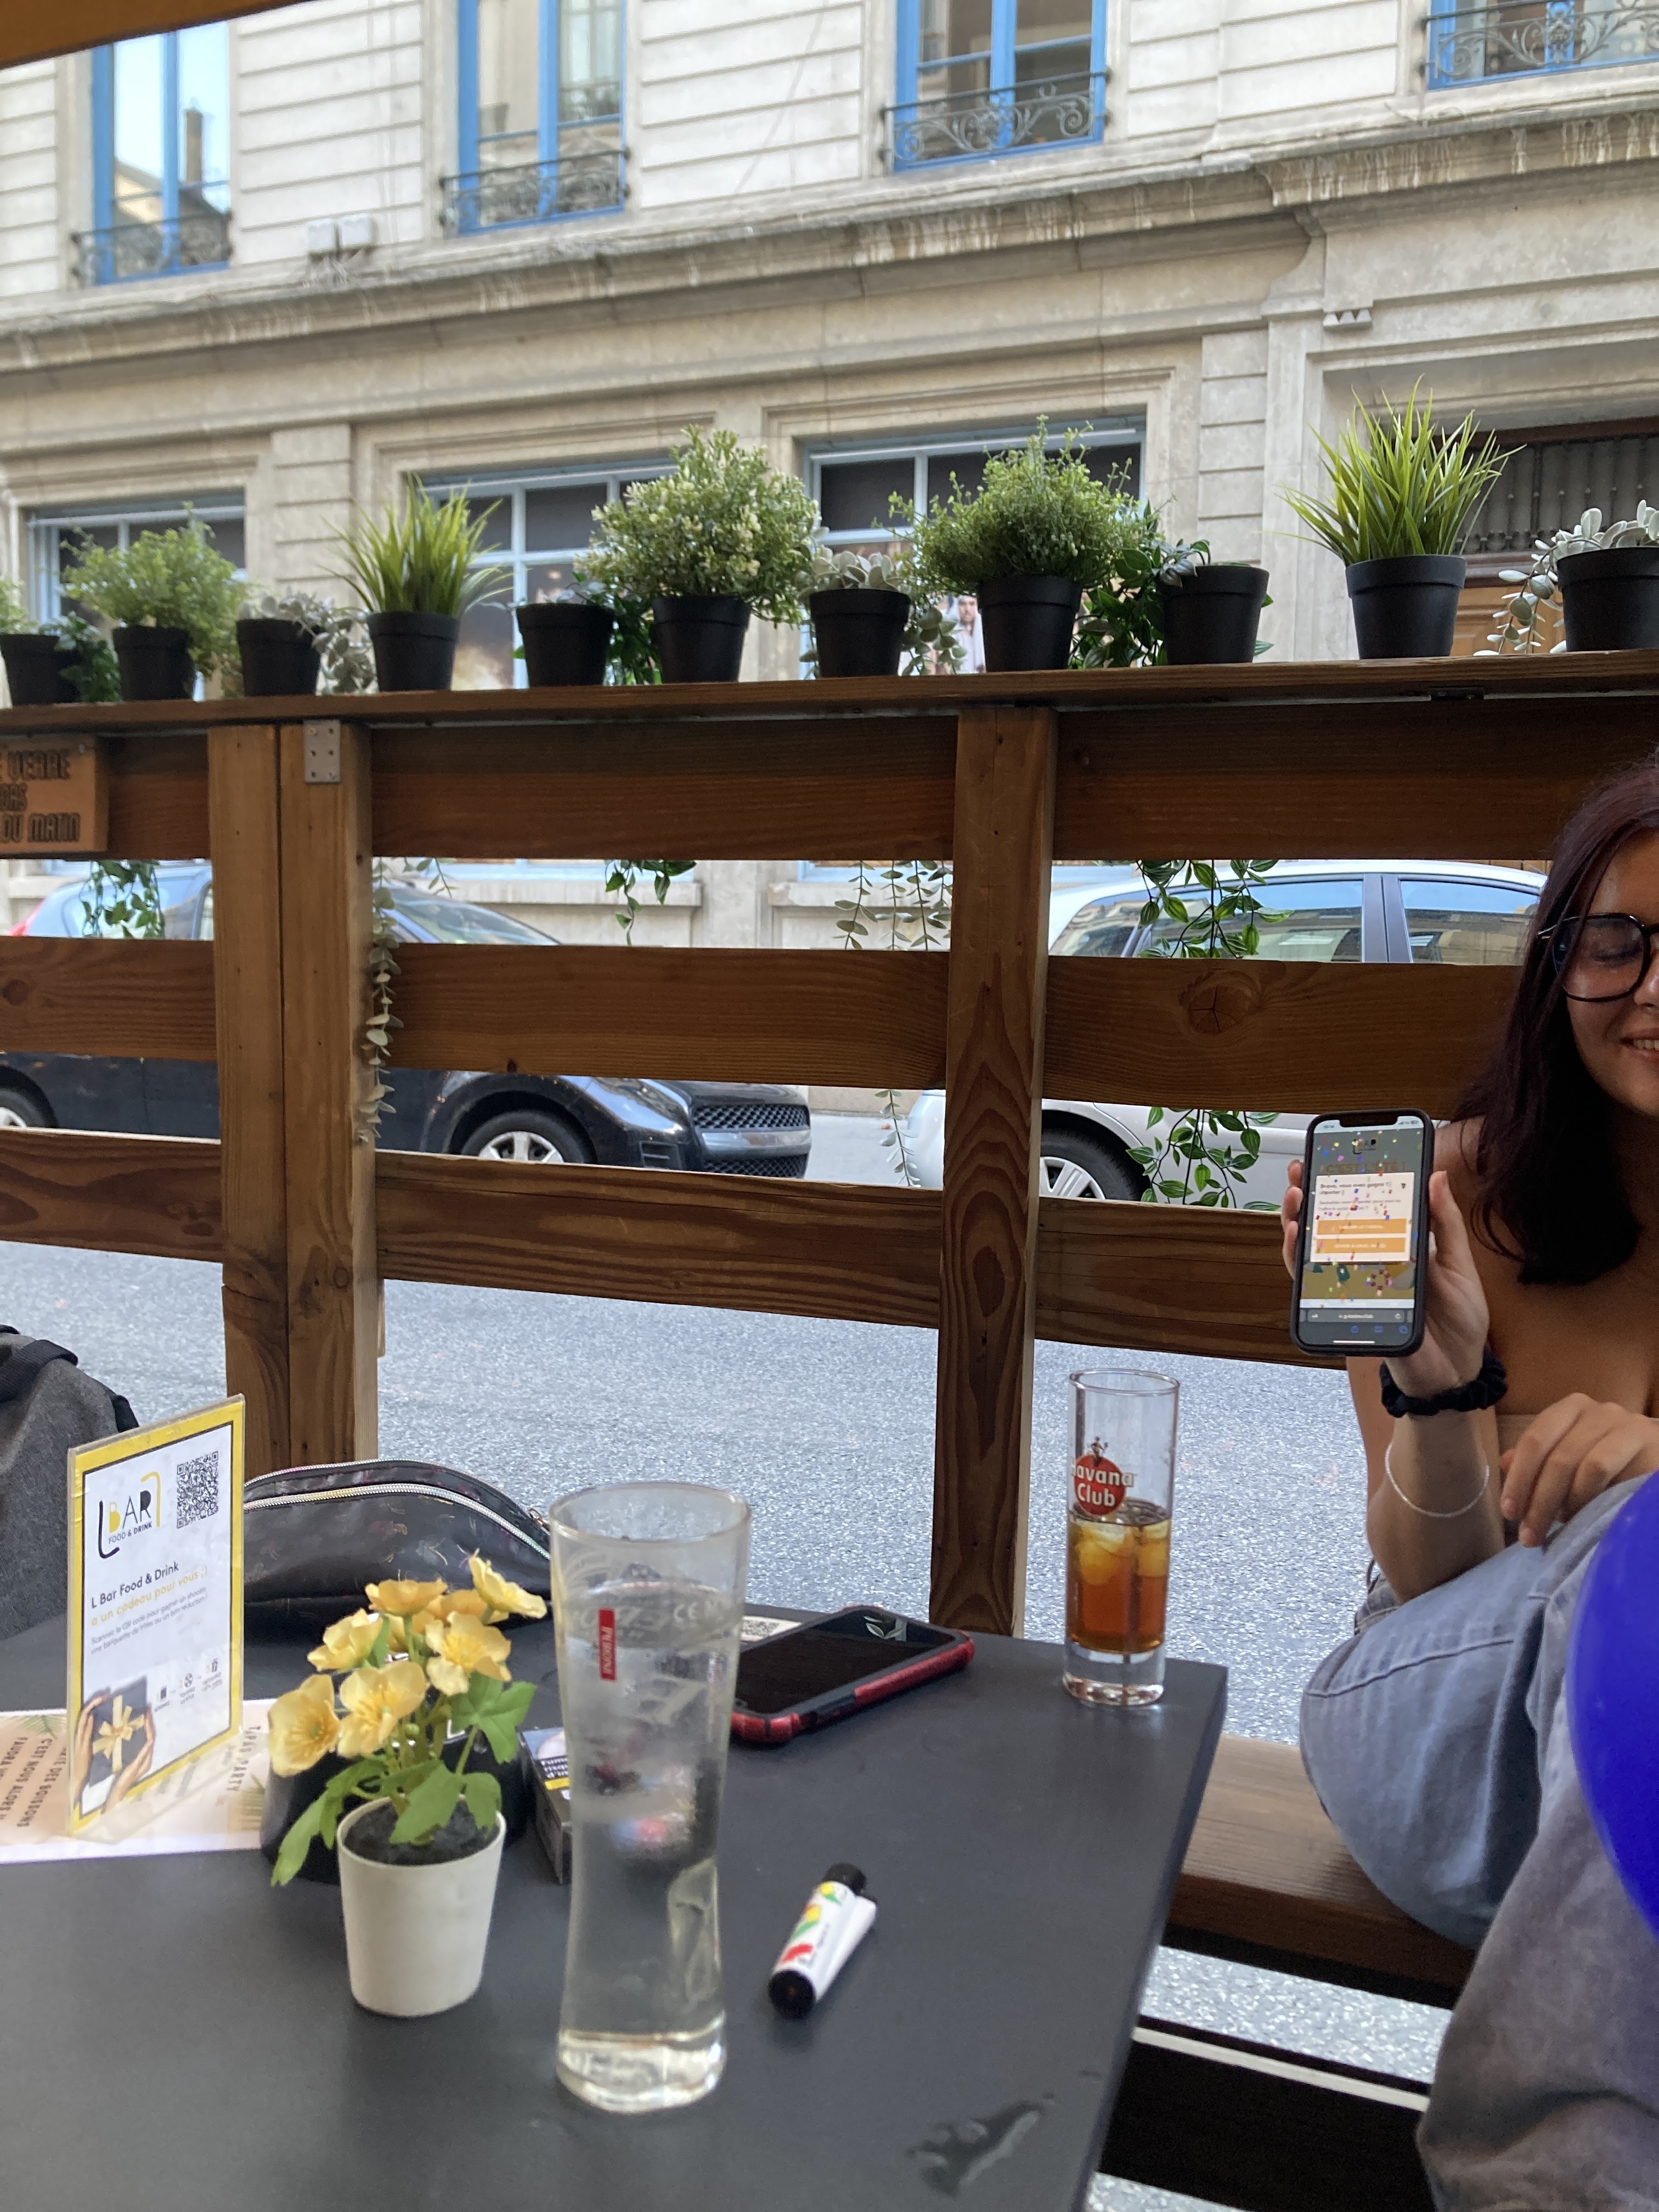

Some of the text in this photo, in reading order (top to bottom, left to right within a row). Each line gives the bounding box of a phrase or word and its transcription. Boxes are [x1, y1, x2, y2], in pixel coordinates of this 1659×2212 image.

[1070, 1457, 1134, 1487] Havana
[109, 1490, 151, 1534] BAR
[1077, 1482, 1116, 1507] Club
[109, 1532, 126, 1544] FOOD
[134, 1521, 152, 1534] DRINK
[92, 1561, 179, 1609] L Bar Food & Drink
[92, 1617, 98, 1626] a
[101, 1610, 114, 1622] un
[116, 1592, 151, 1615] cadeau
[154, 1582, 175, 1601] pour
[178, 1572, 199, 1586] vous
